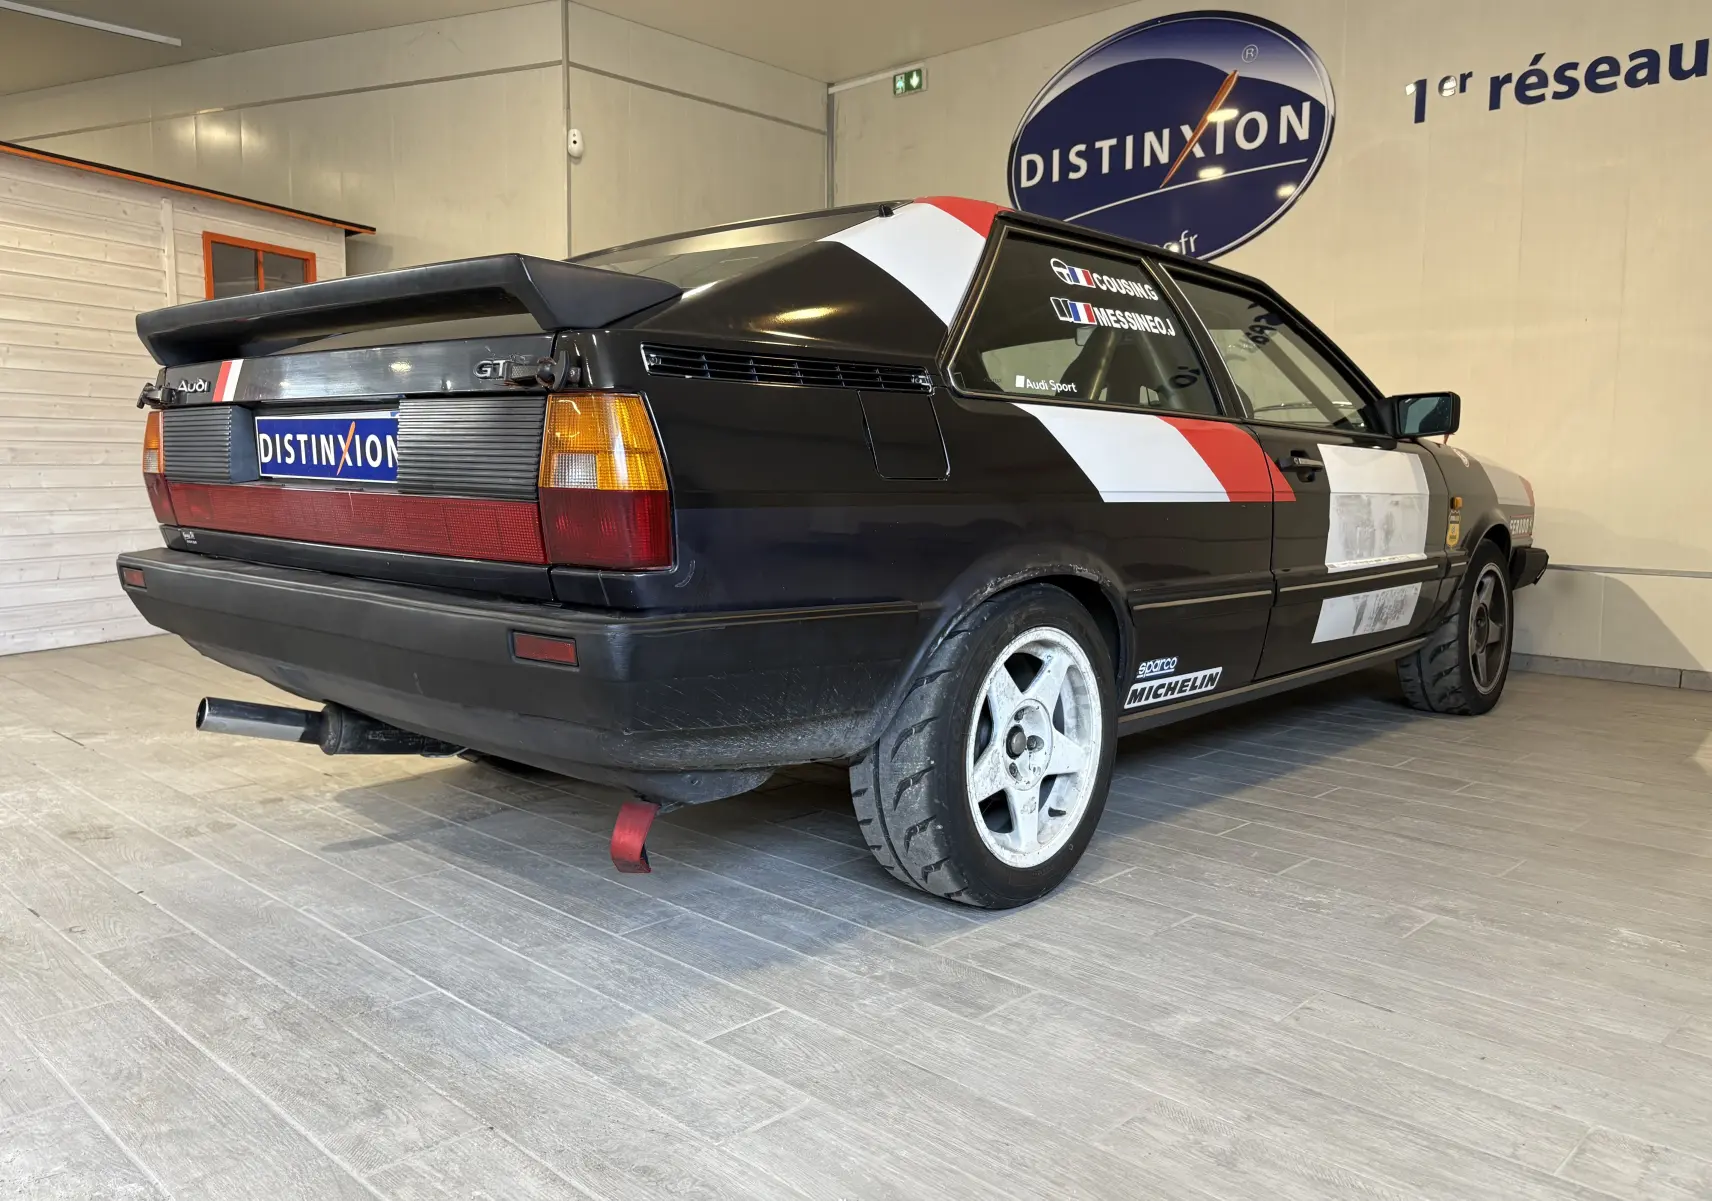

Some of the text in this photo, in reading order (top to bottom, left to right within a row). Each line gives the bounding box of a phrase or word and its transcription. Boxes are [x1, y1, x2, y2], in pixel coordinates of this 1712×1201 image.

[1488, 38, 1711, 111] réseau
[1020, 98, 1312, 188] DISTINXION
[1093, 306, 1176, 337] MESSINEO.J
[178, 378, 208, 393] Audi
[1026, 378, 1078, 393] Audi Sport
[1137, 656, 1178, 679] sparco
[1126, 671, 1220, 706] MICHELIN
